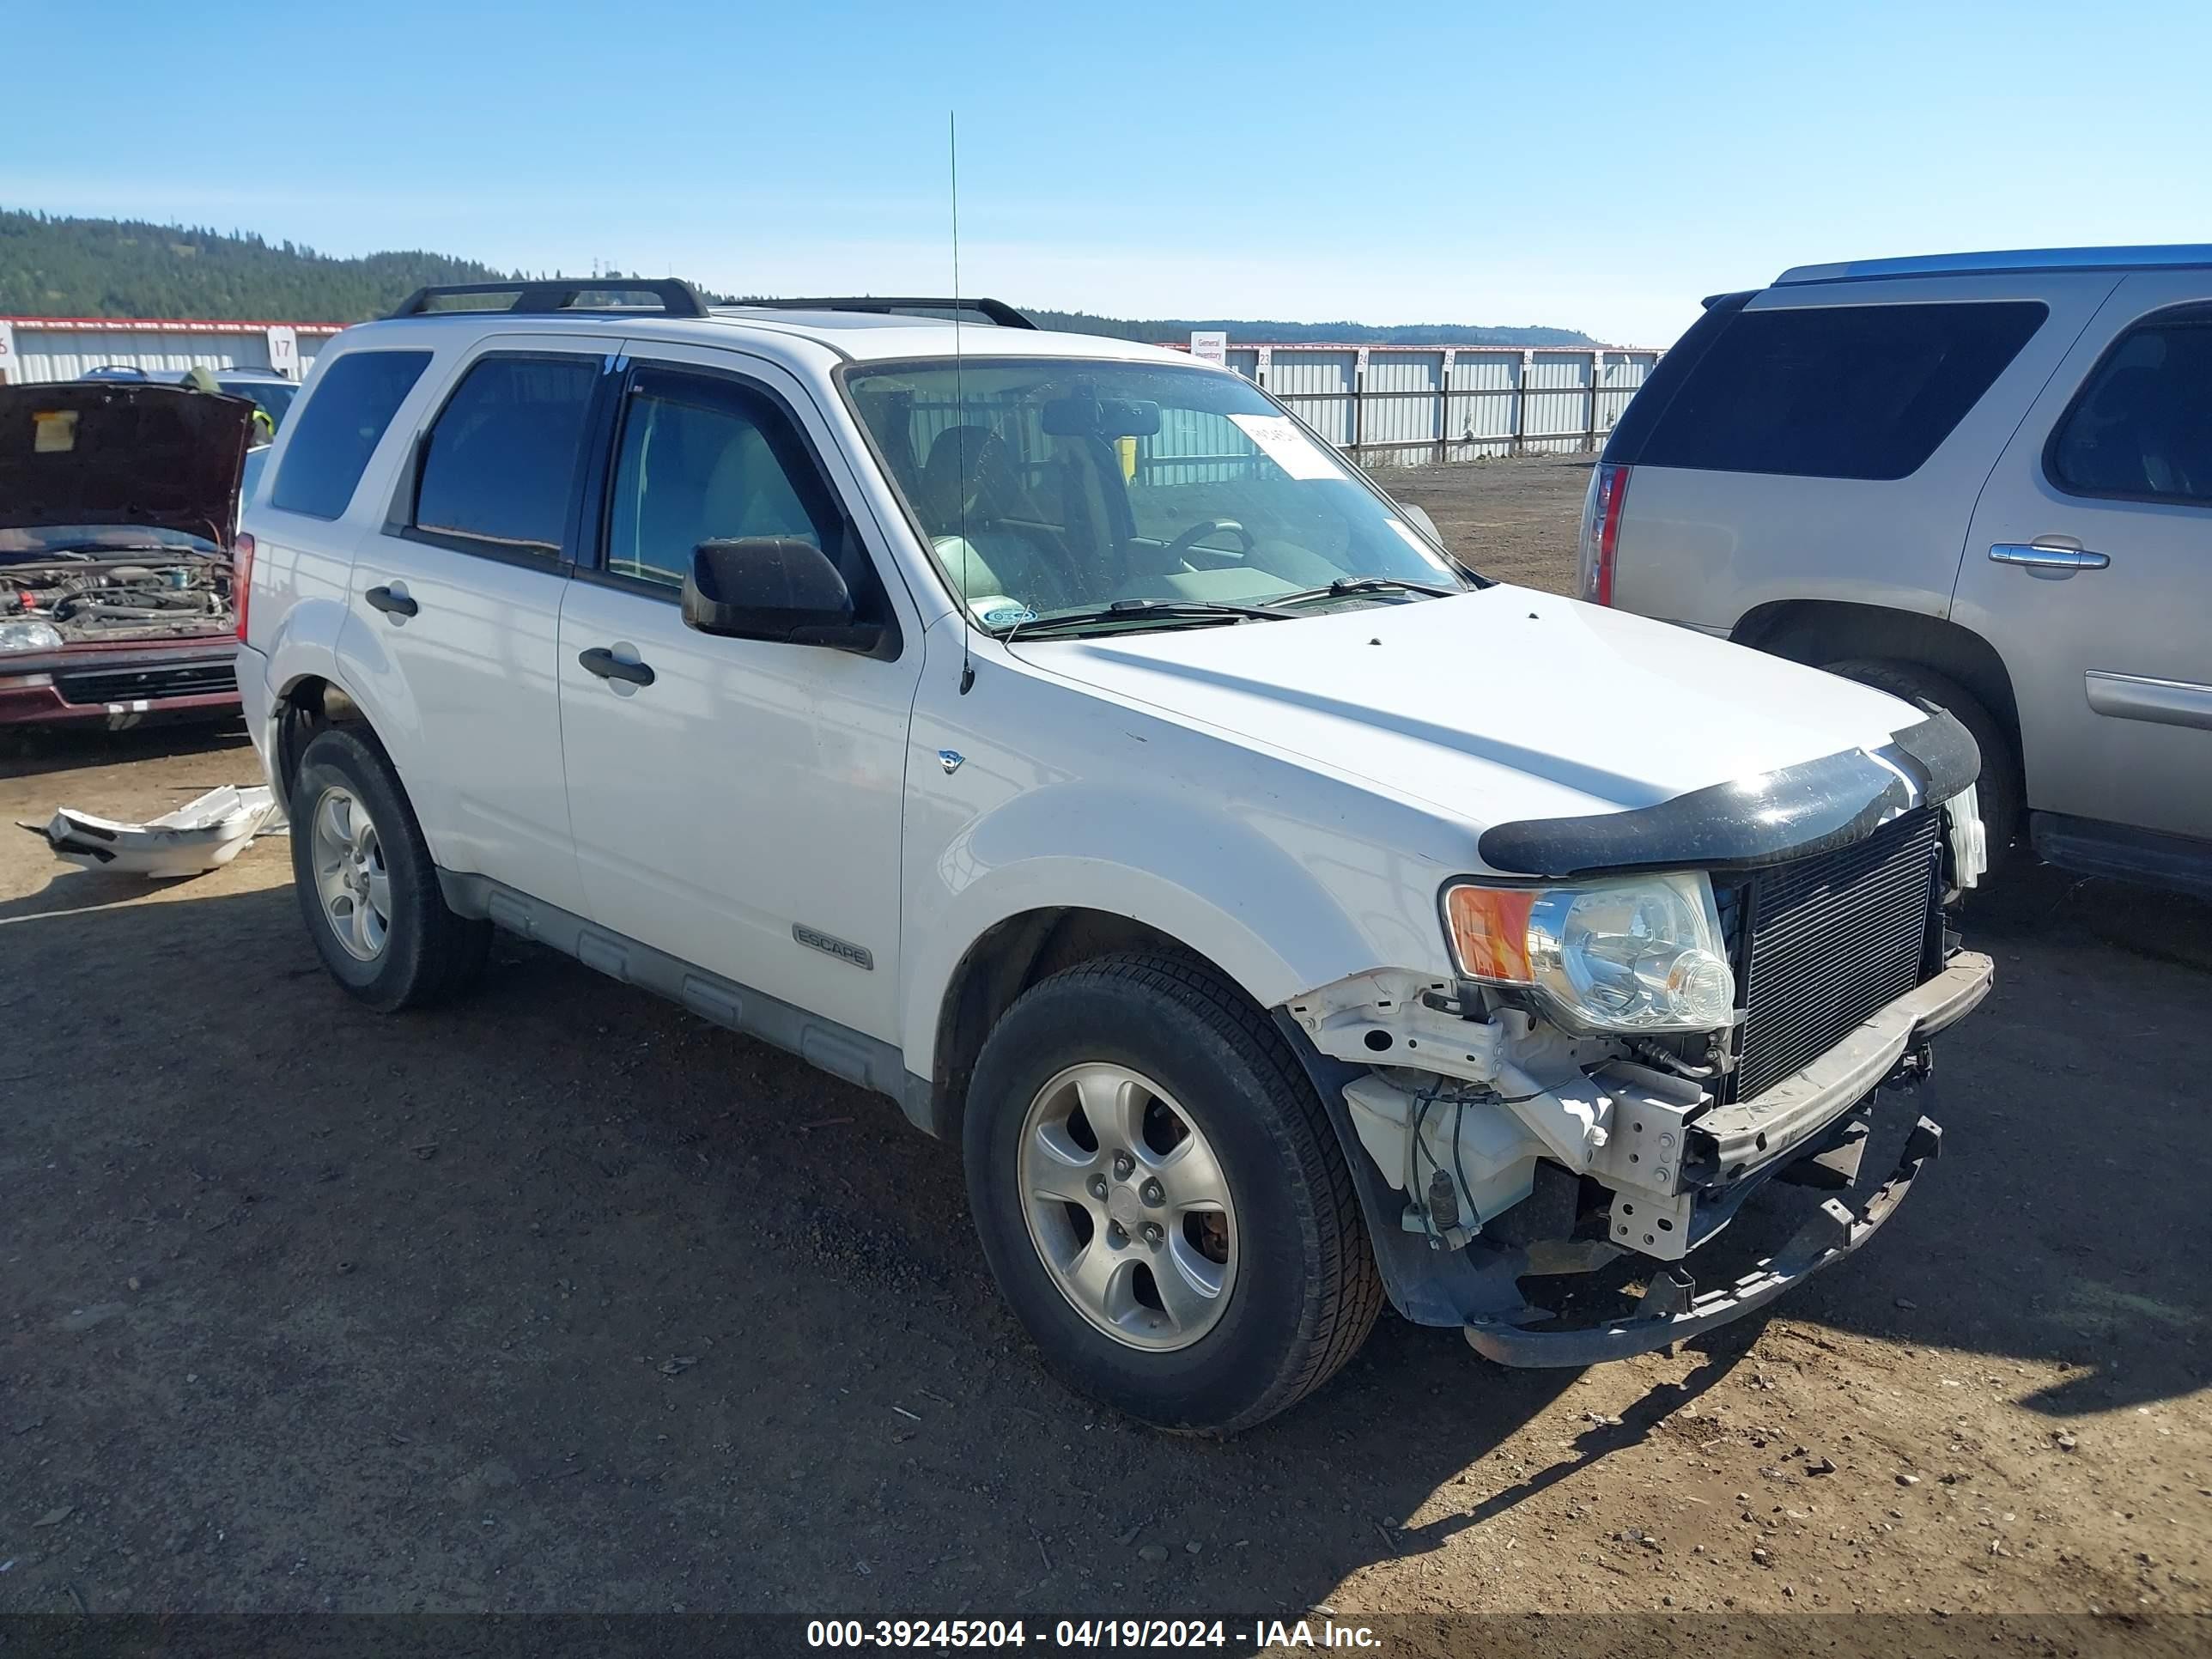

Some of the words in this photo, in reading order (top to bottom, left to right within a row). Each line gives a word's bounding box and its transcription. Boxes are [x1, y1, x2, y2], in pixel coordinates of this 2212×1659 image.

[275, 340, 290, 357] 17
[1198, 338, 1220, 347] General
[1259, 354, 1270, 366] 23
[1358, 354, 1368, 365] 24
[798, 929, 866, 965] ESCAPE
